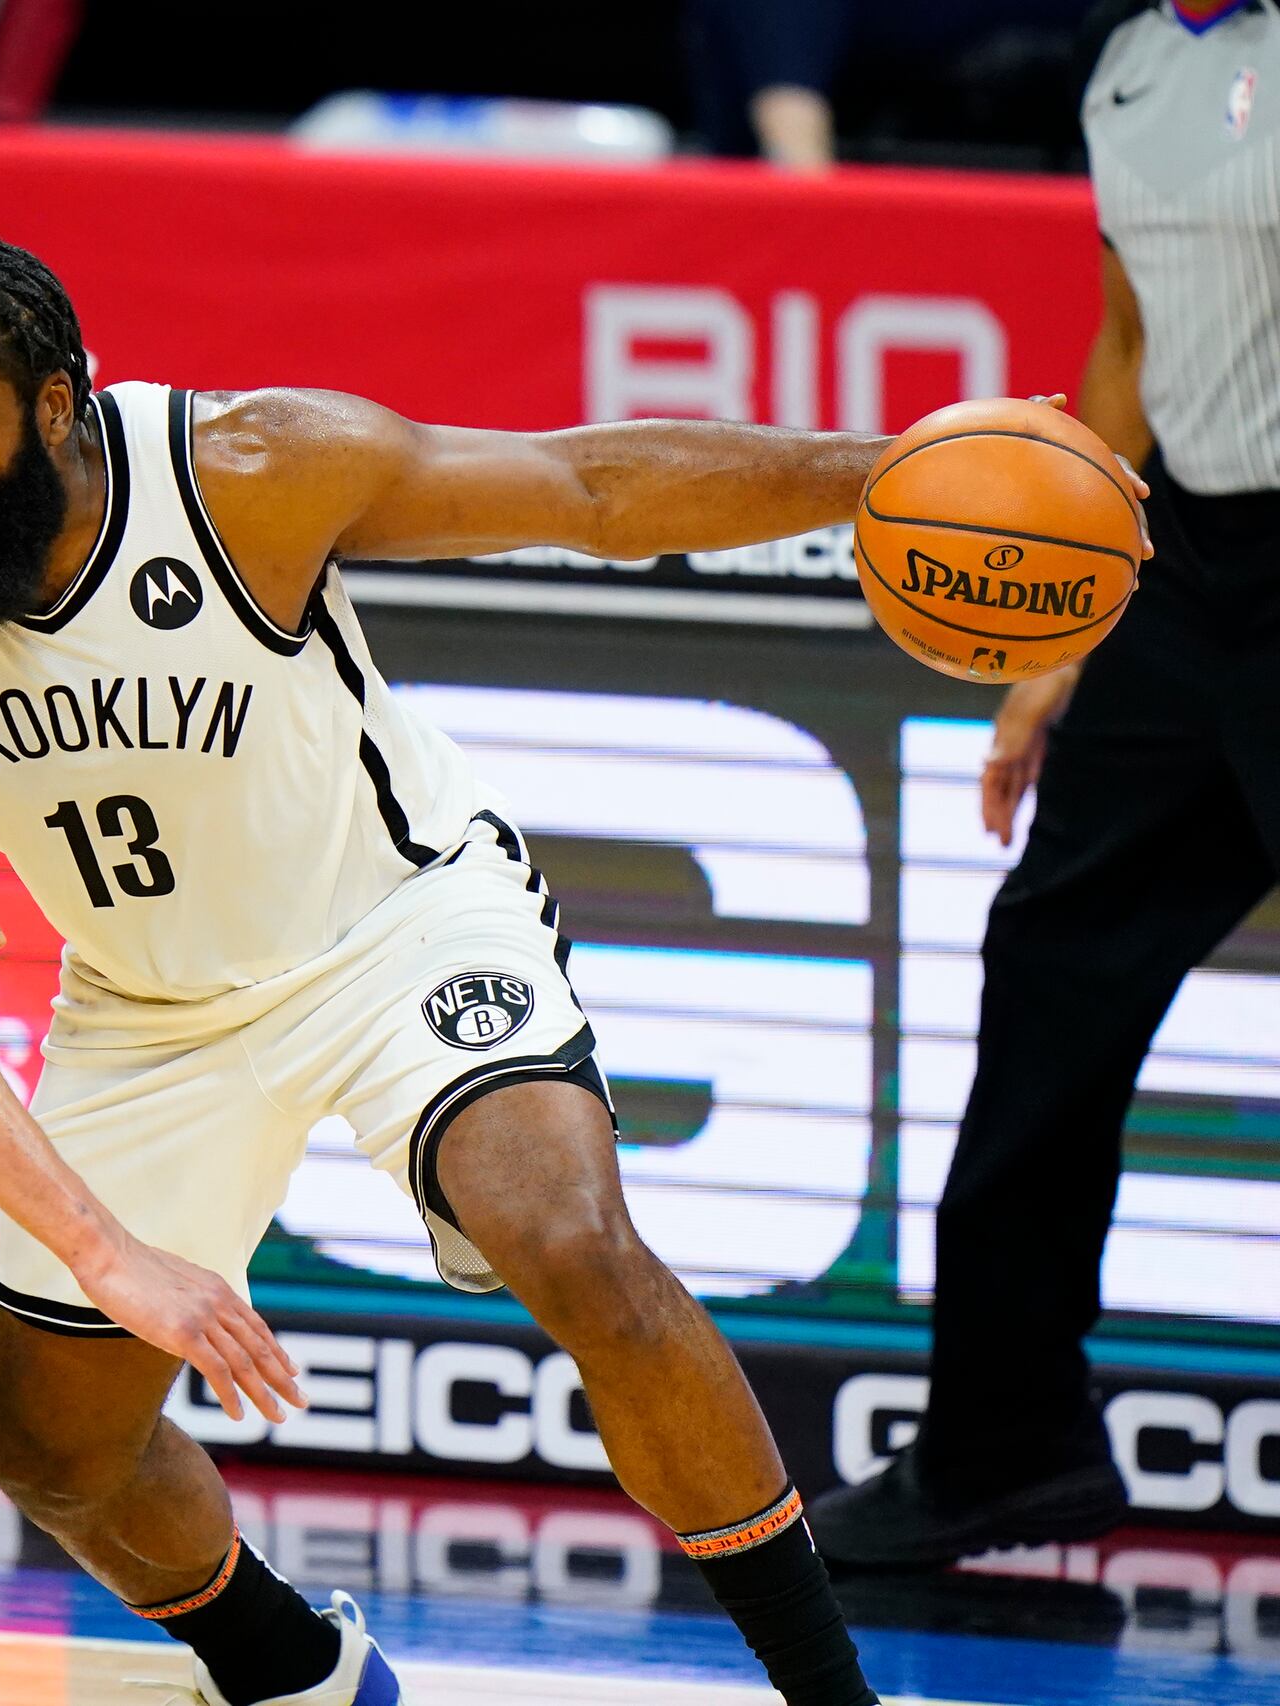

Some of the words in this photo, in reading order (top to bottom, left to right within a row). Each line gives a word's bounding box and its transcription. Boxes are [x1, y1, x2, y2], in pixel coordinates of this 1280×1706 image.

[901, 547, 1096, 618] SPALDING
[45, 794, 177, 908] 13
[429, 976, 529, 1027] NETS
[473, 1009, 494, 1037] B
